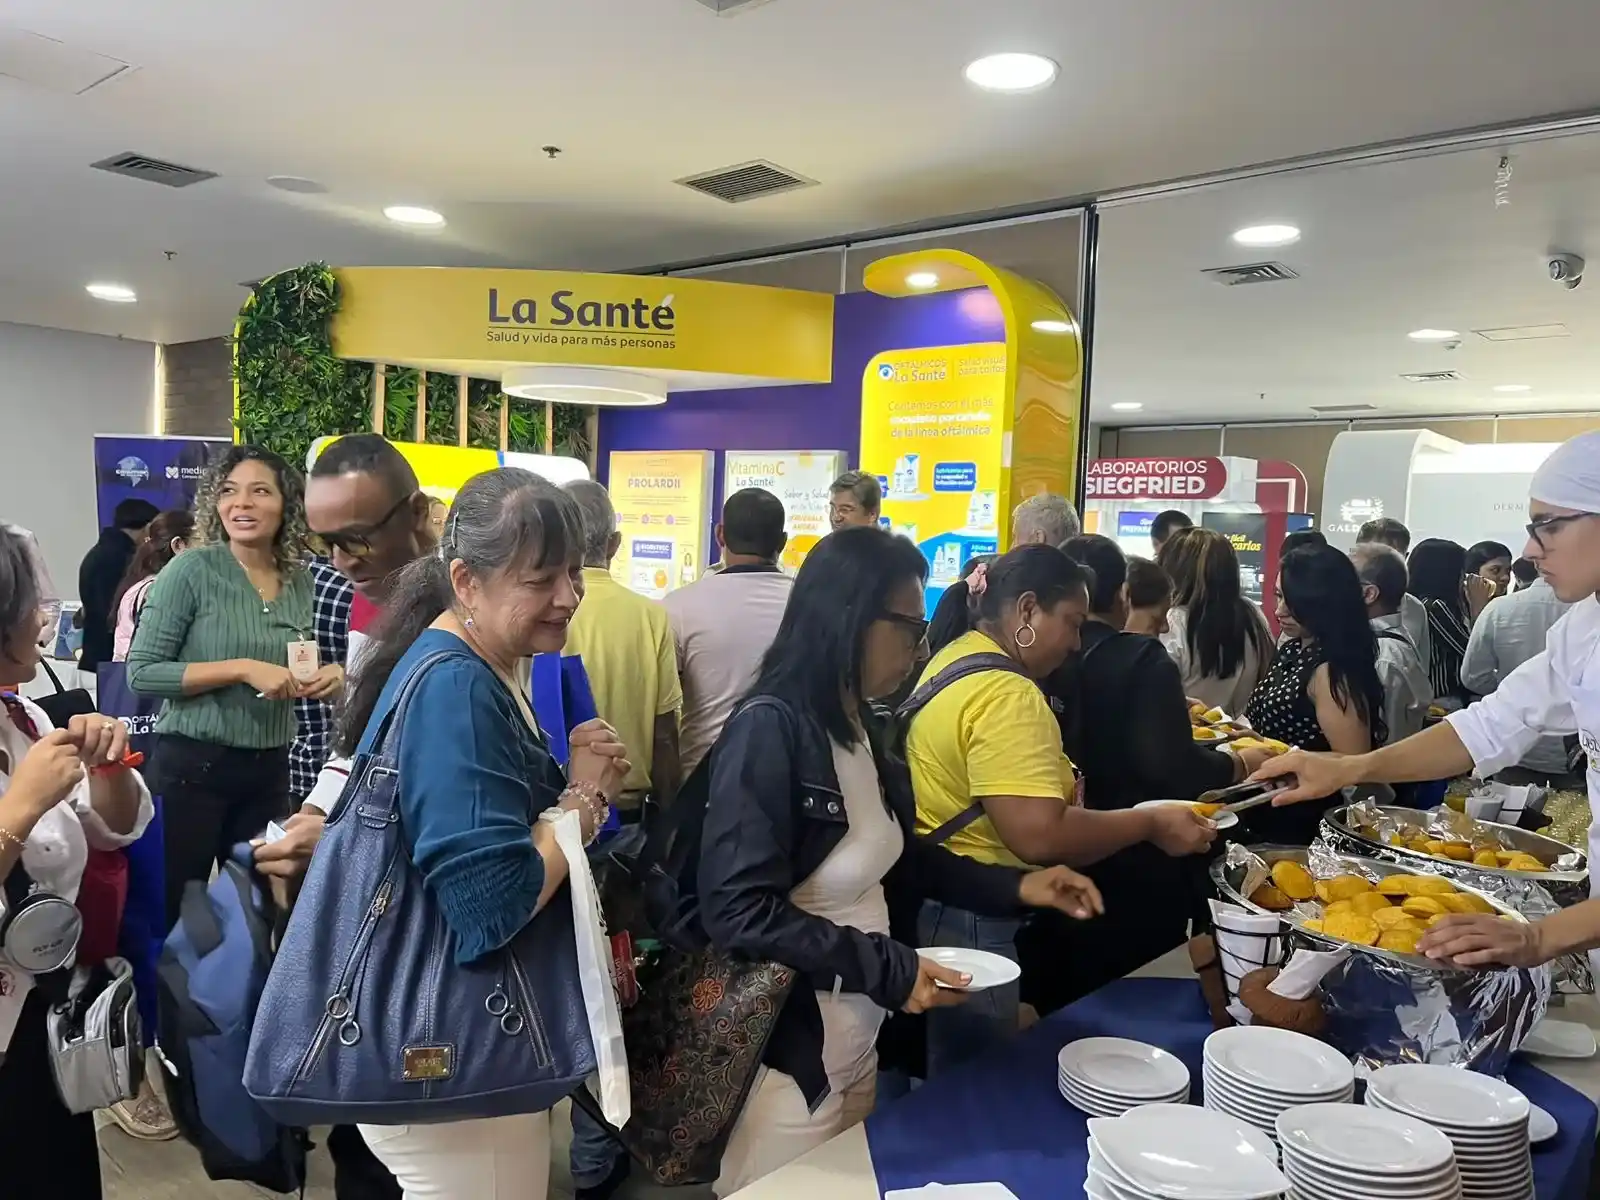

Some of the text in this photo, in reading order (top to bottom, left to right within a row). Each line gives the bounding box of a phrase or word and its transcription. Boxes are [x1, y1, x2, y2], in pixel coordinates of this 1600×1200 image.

[488, 288, 675, 331] La Santé
[486, 331, 676, 349] Salud y vida para más personas
[894, 369, 946, 382] La Santé
[1086, 461, 1208, 475] LABORATORIOS
[736, 477, 746, 487] La
[1086, 476, 1206, 495] SIEGFRIED
[1493, 502, 1524, 511] DERM
[1328, 523, 1361, 533] GALD
[133, 724, 149, 735] La
